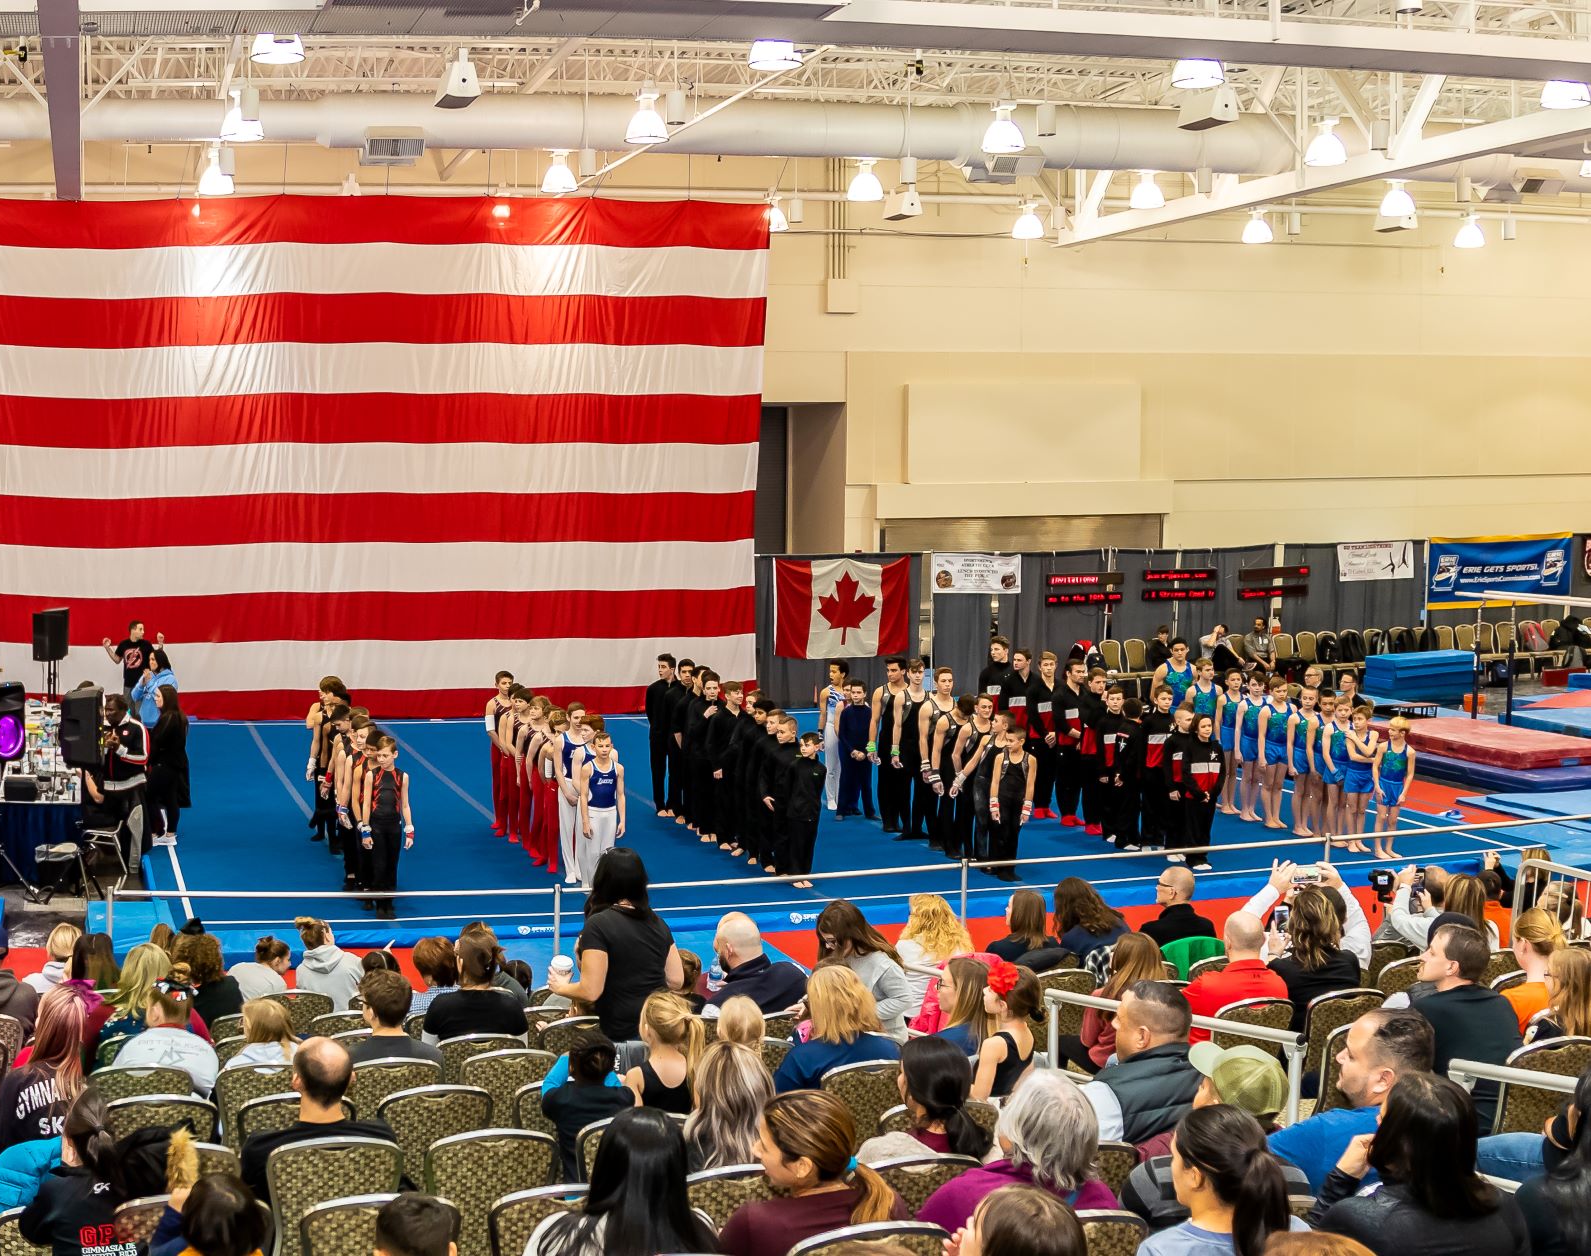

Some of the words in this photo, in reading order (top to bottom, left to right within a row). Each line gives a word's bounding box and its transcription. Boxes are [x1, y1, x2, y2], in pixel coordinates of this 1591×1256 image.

[1462, 566, 1482, 574] ERIE
[1483, 565, 1504, 573] GETS
[16, 1077, 61, 1120] GYMNA
[38, 1115, 66, 1135] SK
[81, 1243, 125, 1254] GIMNASIA
[125, 1241, 137, 1250] DE
